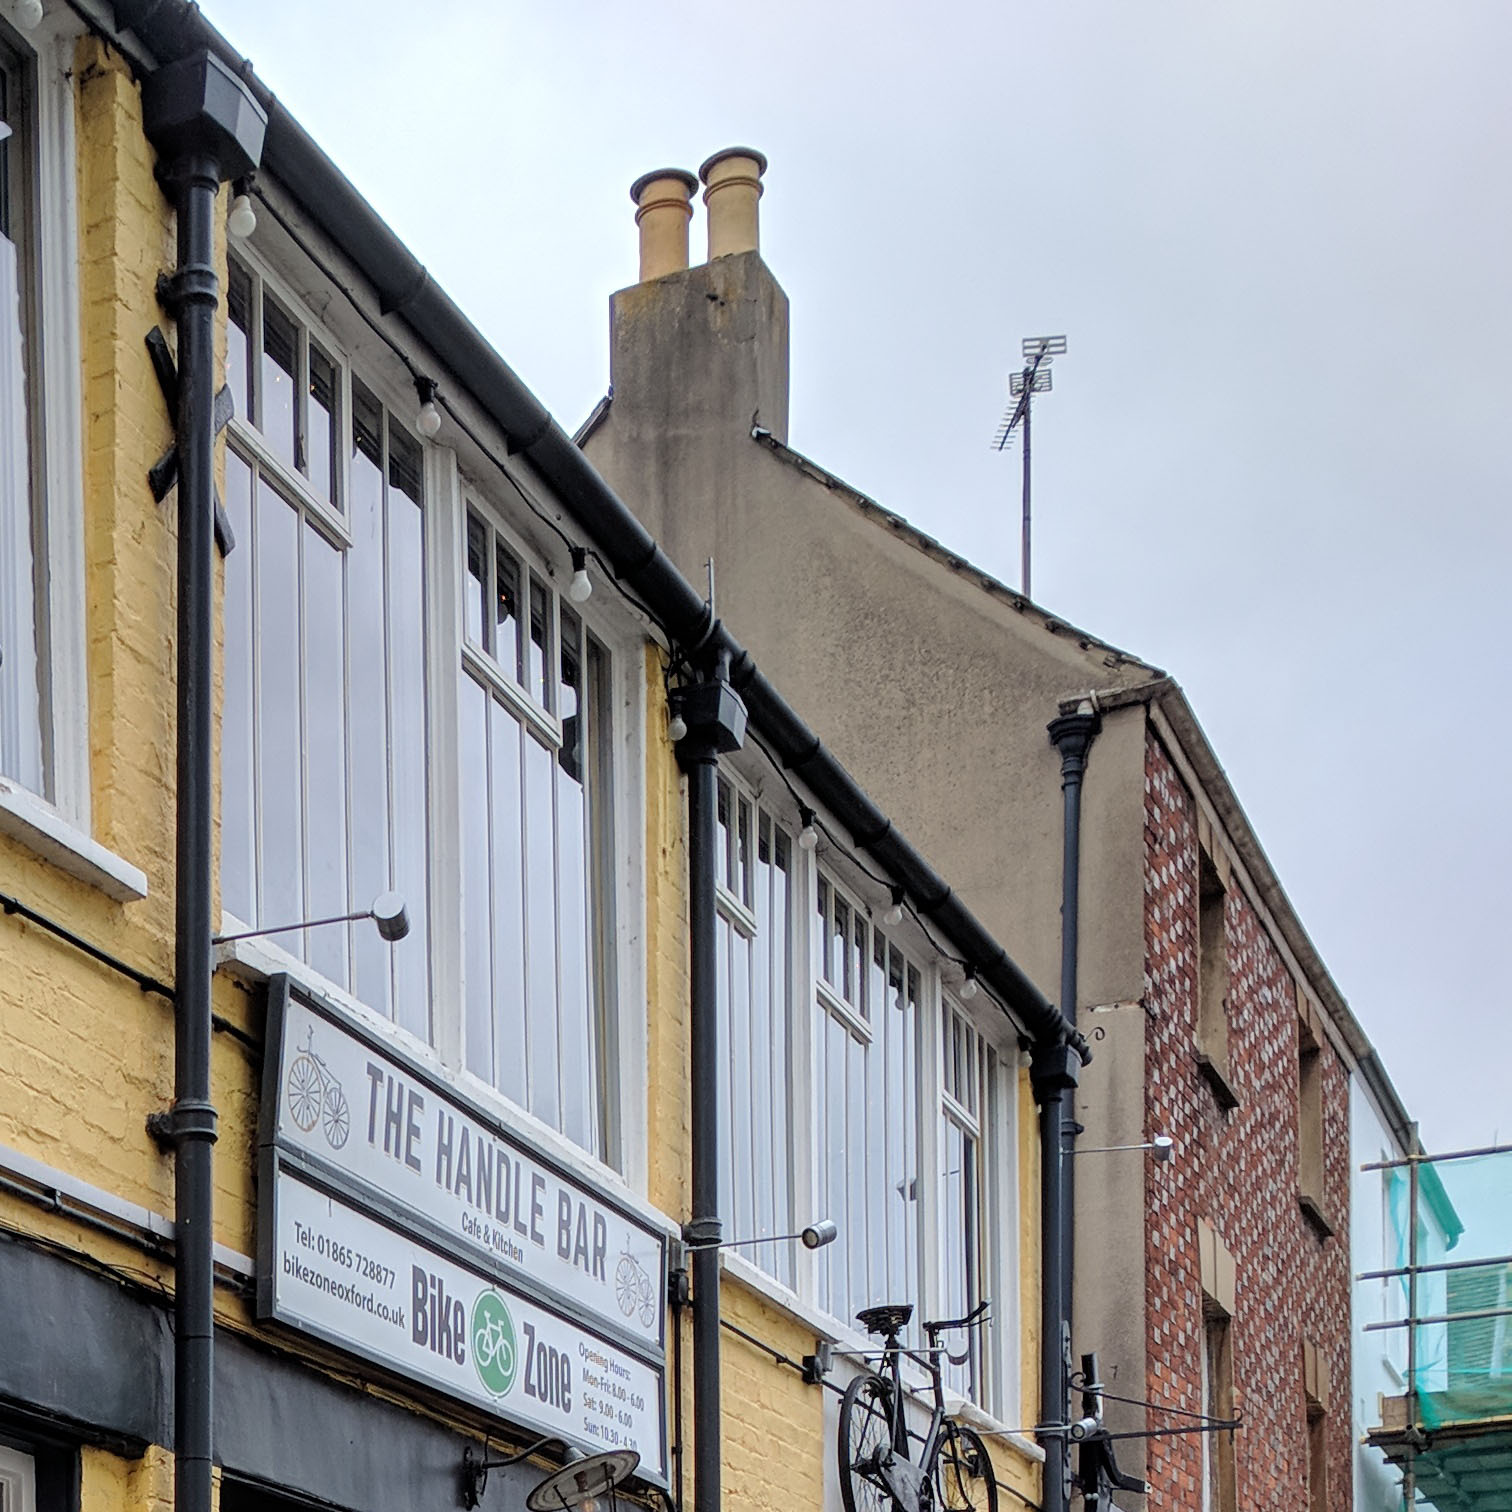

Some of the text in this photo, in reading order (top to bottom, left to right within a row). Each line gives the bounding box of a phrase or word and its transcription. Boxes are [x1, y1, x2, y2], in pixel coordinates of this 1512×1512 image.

[366, 1061, 608, 1283] THE HANDLE BAR
[295, 1221, 396, 1290] Tel: 01865 728877
[462, 1211, 523, 1264] Cafe & Kitchen
[283, 1251, 405, 1329] bikezoneoxford.co.uk
[412, 1264, 572, 1414] Bike Zone
[579, 1342, 631, 1381] Opening Hours:
